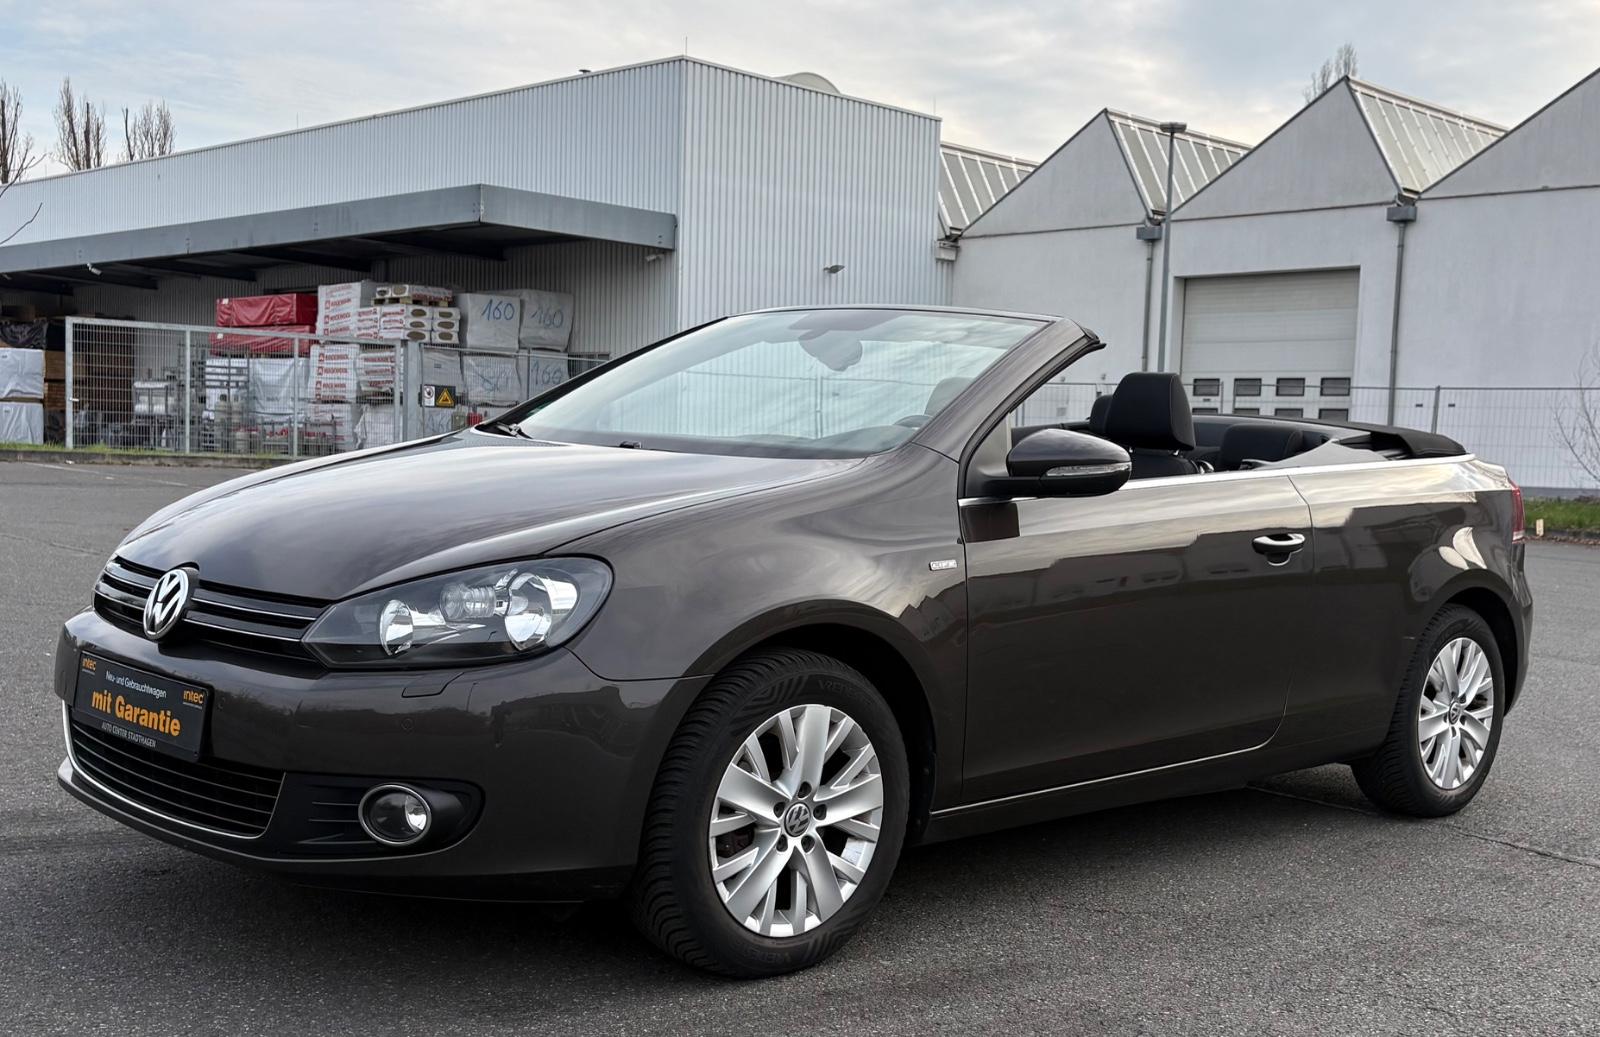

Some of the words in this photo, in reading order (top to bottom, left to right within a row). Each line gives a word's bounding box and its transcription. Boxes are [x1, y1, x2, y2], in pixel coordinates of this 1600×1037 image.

[481, 299, 515, 321] 160
[531, 308, 565, 329] 160
[82, 658, 97, 671] intec
[116, 675, 125, 686] und
[124, 677, 167, 699] Gebrauchtwagen
[182, 689, 204, 704] intec
[91, 689, 112, 714] mit
[115, 695, 181, 736] Garantie
[101, 721, 112, 733] AUTO
[112, 725, 128, 738] CENTER
